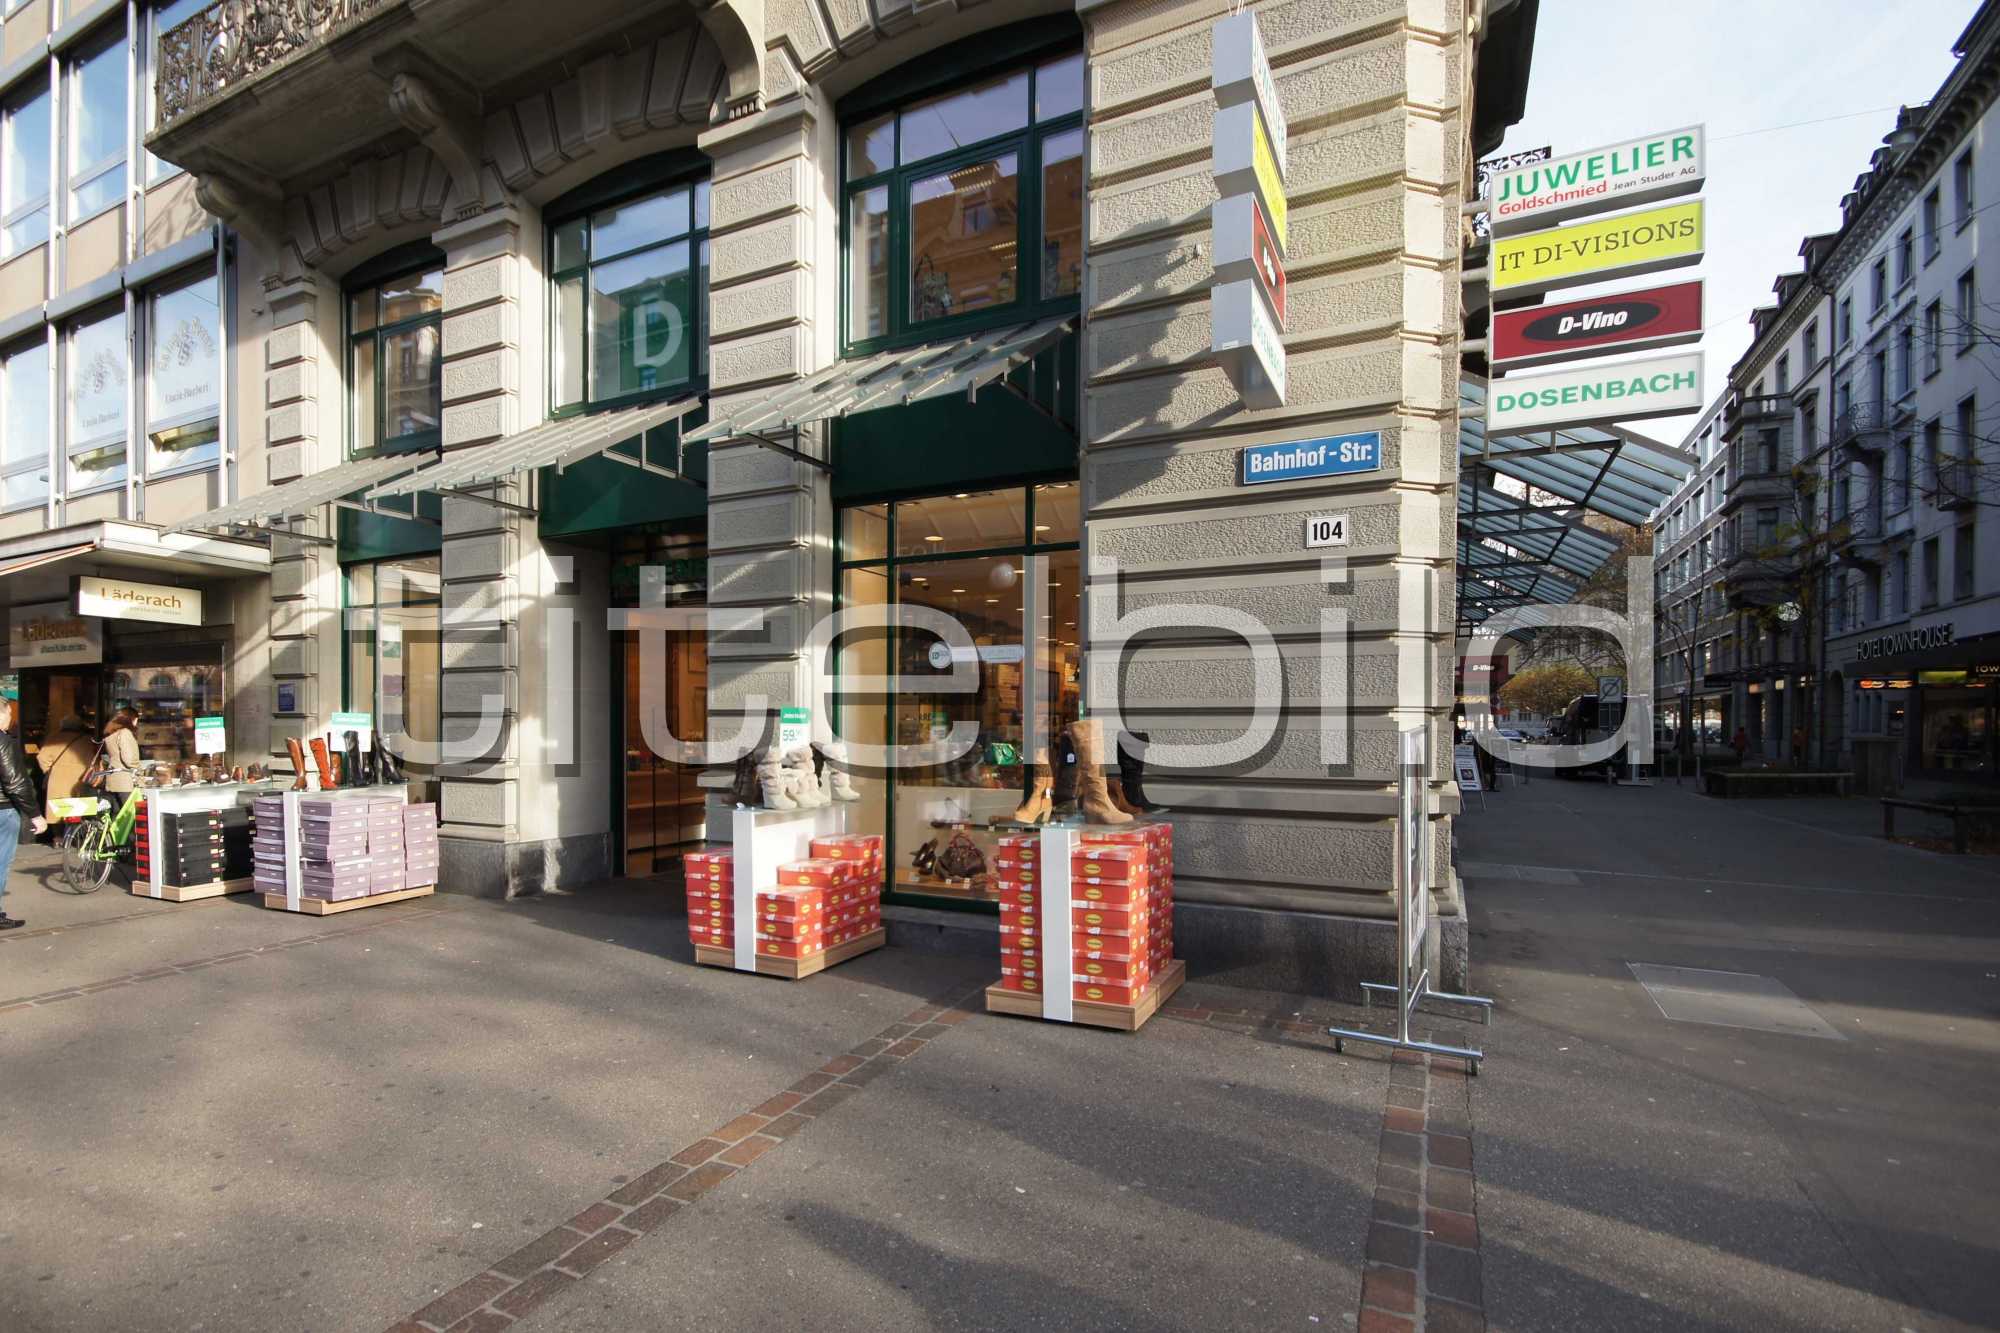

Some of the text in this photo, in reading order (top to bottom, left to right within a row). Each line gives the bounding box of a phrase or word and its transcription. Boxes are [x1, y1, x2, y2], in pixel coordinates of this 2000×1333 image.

[1498, 135, 1696, 201] JUWELIER
[1498, 165, 1696, 215] Goldschmied Jean Studer AG
[1499, 217, 1696, 272] IT DI-VISIONS
[633, 299, 683, 367] D
[1557, 309, 1628, 336] D-Vino
[1496, 370, 1696, 413] DOSENBACH
[1312, 520, 1343, 541] 104
[1856, 623, 1949, 660] HOTEL TOWNHOUSE
